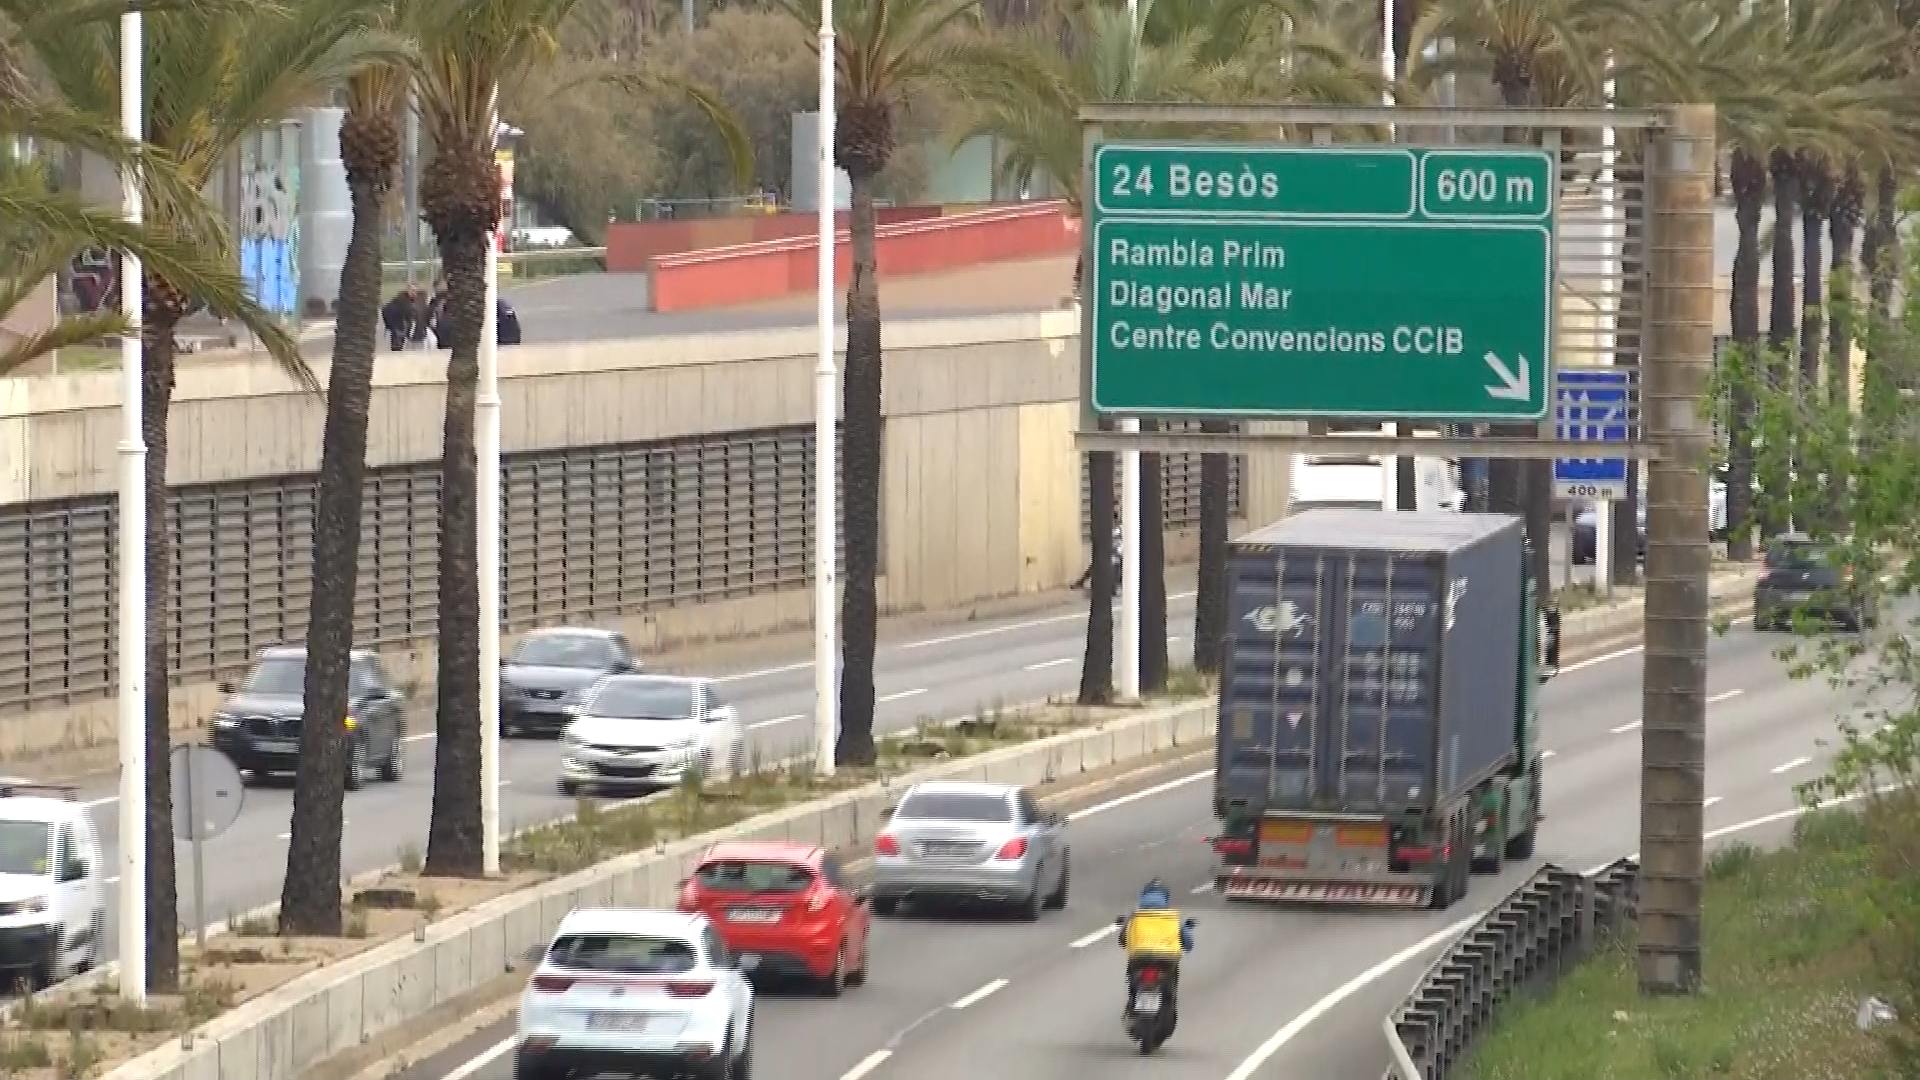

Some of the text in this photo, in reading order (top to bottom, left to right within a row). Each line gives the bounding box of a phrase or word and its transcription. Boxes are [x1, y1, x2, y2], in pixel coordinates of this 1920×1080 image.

[1111, 164, 1279, 198] 24 Besòs
[1437, 169, 1534, 202] 600 m
[1110, 238, 1285, 268] Rambla Prim
[1110, 280, 1292, 314] Diagonal Mar
[1110, 321, 1464, 354] Centre Convencions CCIB
[1567, 485, 1597, 496] 400
